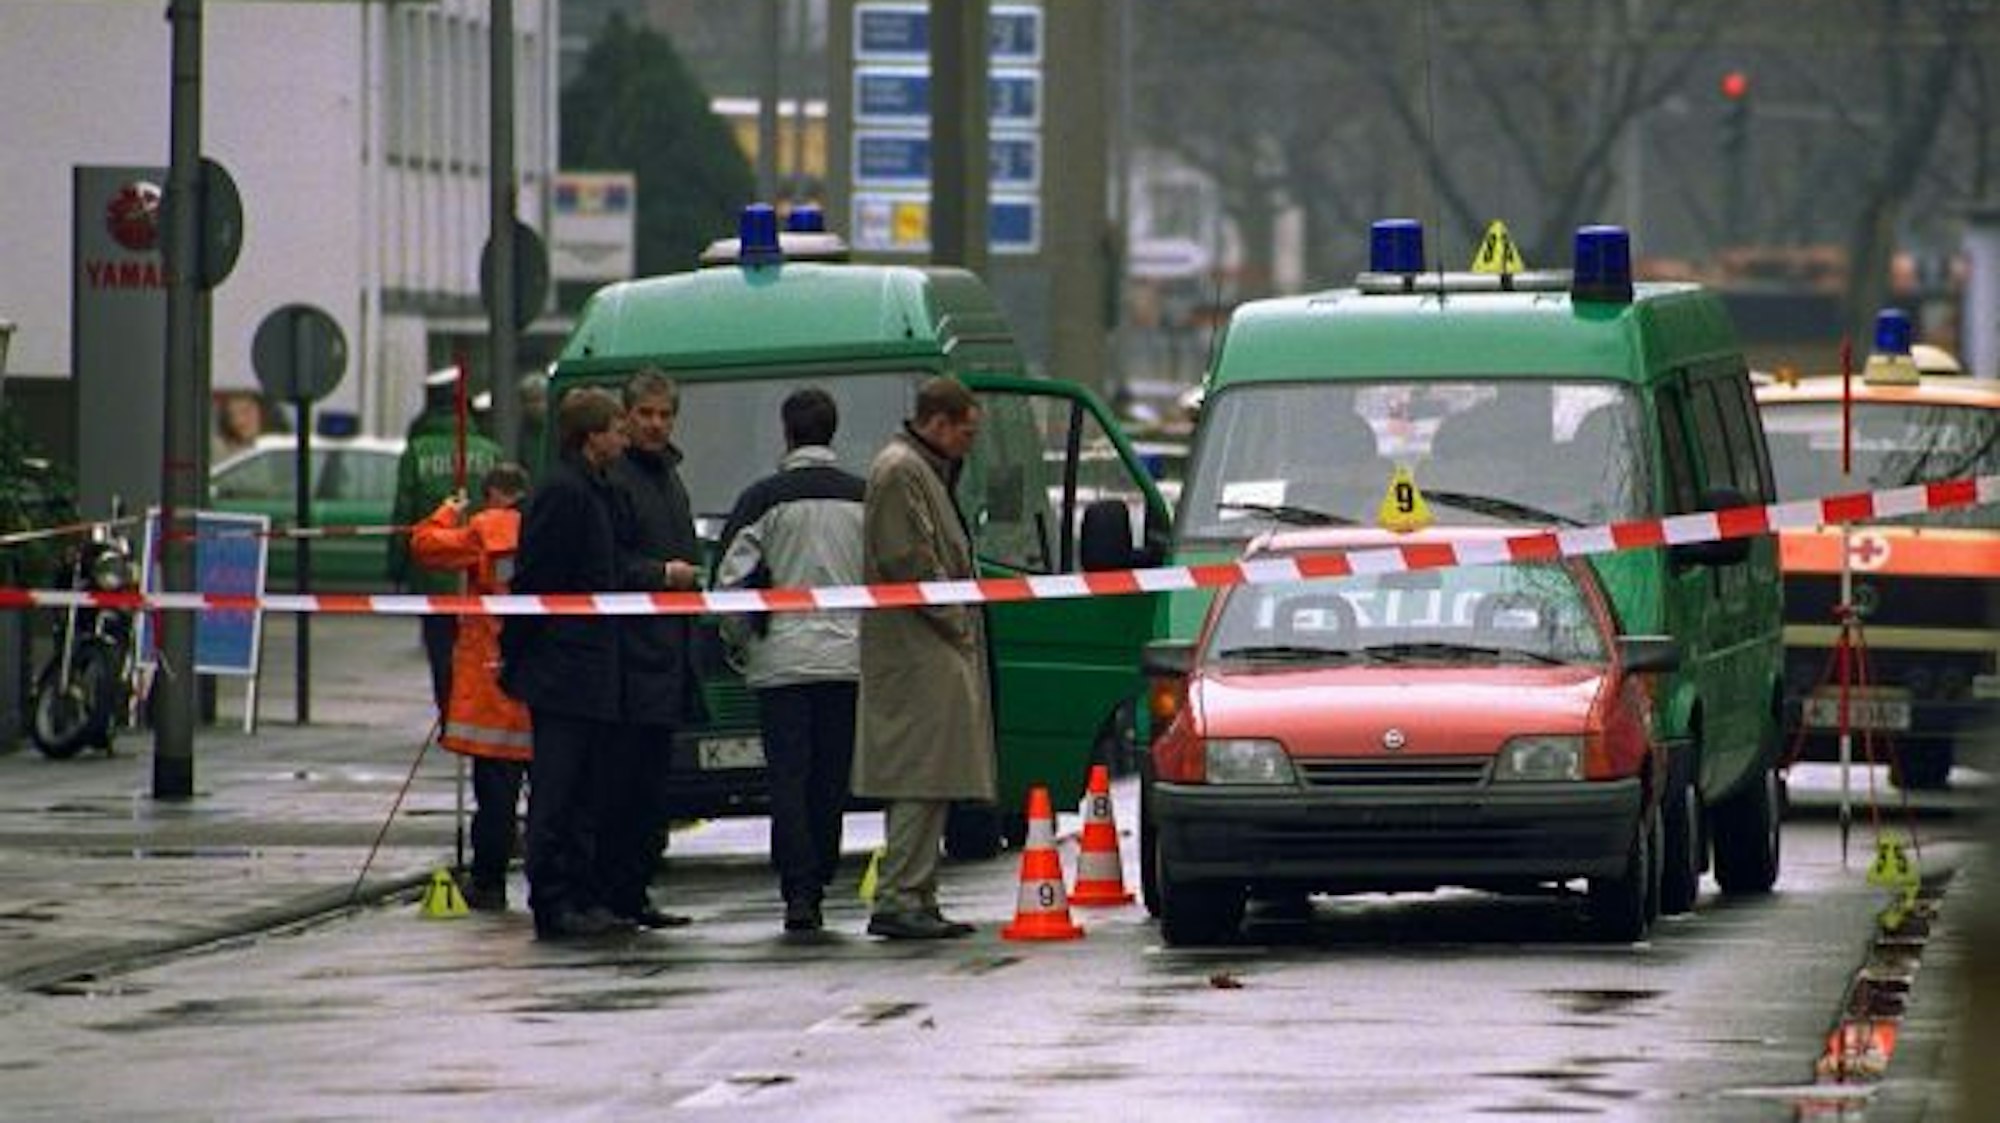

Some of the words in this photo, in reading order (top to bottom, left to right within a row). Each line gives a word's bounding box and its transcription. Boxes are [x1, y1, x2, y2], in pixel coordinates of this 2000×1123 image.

[85, 259, 167, 288] YAMA
[1396, 483, 1413, 513] 9
[1093, 798, 1107, 817] 8
[1039, 883, 1055, 907] 9
